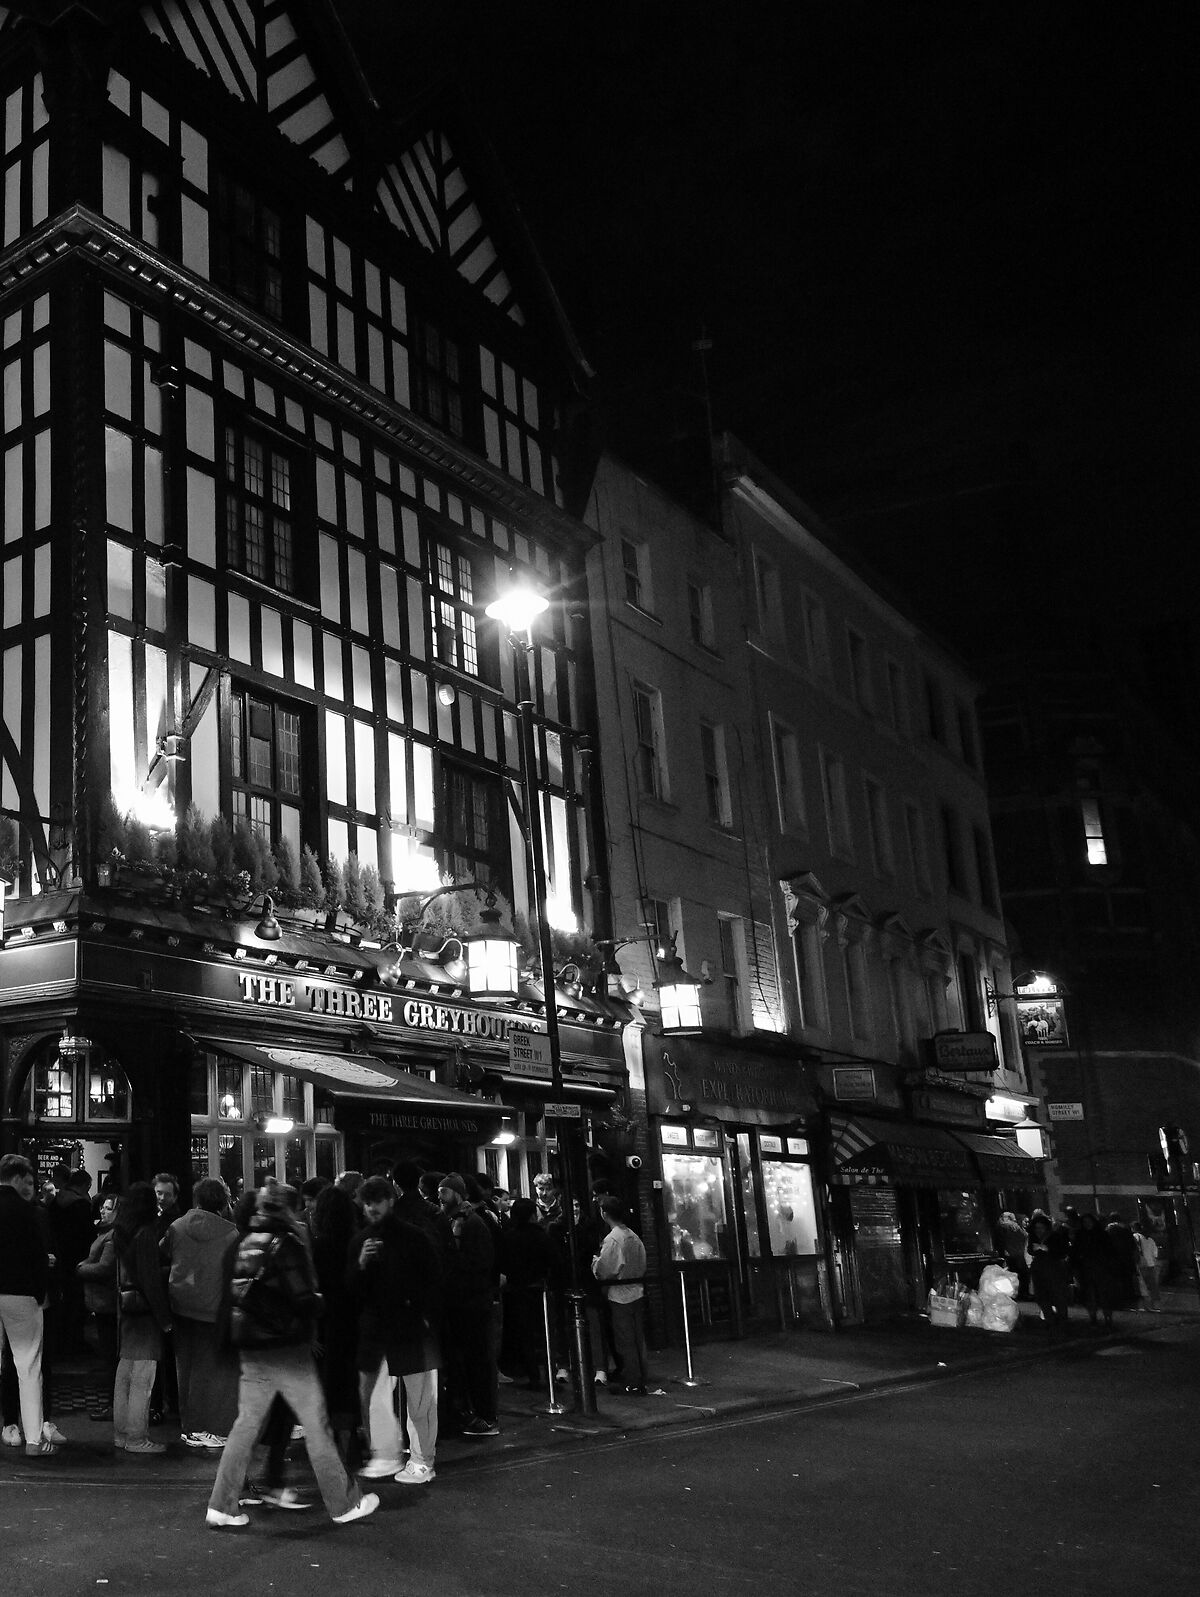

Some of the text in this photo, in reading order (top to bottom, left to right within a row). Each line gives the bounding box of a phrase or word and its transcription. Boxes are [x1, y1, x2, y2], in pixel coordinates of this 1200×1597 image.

[239, 972, 296, 1006] THE
[305, 985, 393, 1022] THREE
[513, 1034, 531, 1047] GREEK
[513, 1047, 533, 1059] STREET
[369, 1112, 389, 1127] THE
[391, 1113, 419, 1129] THREE
